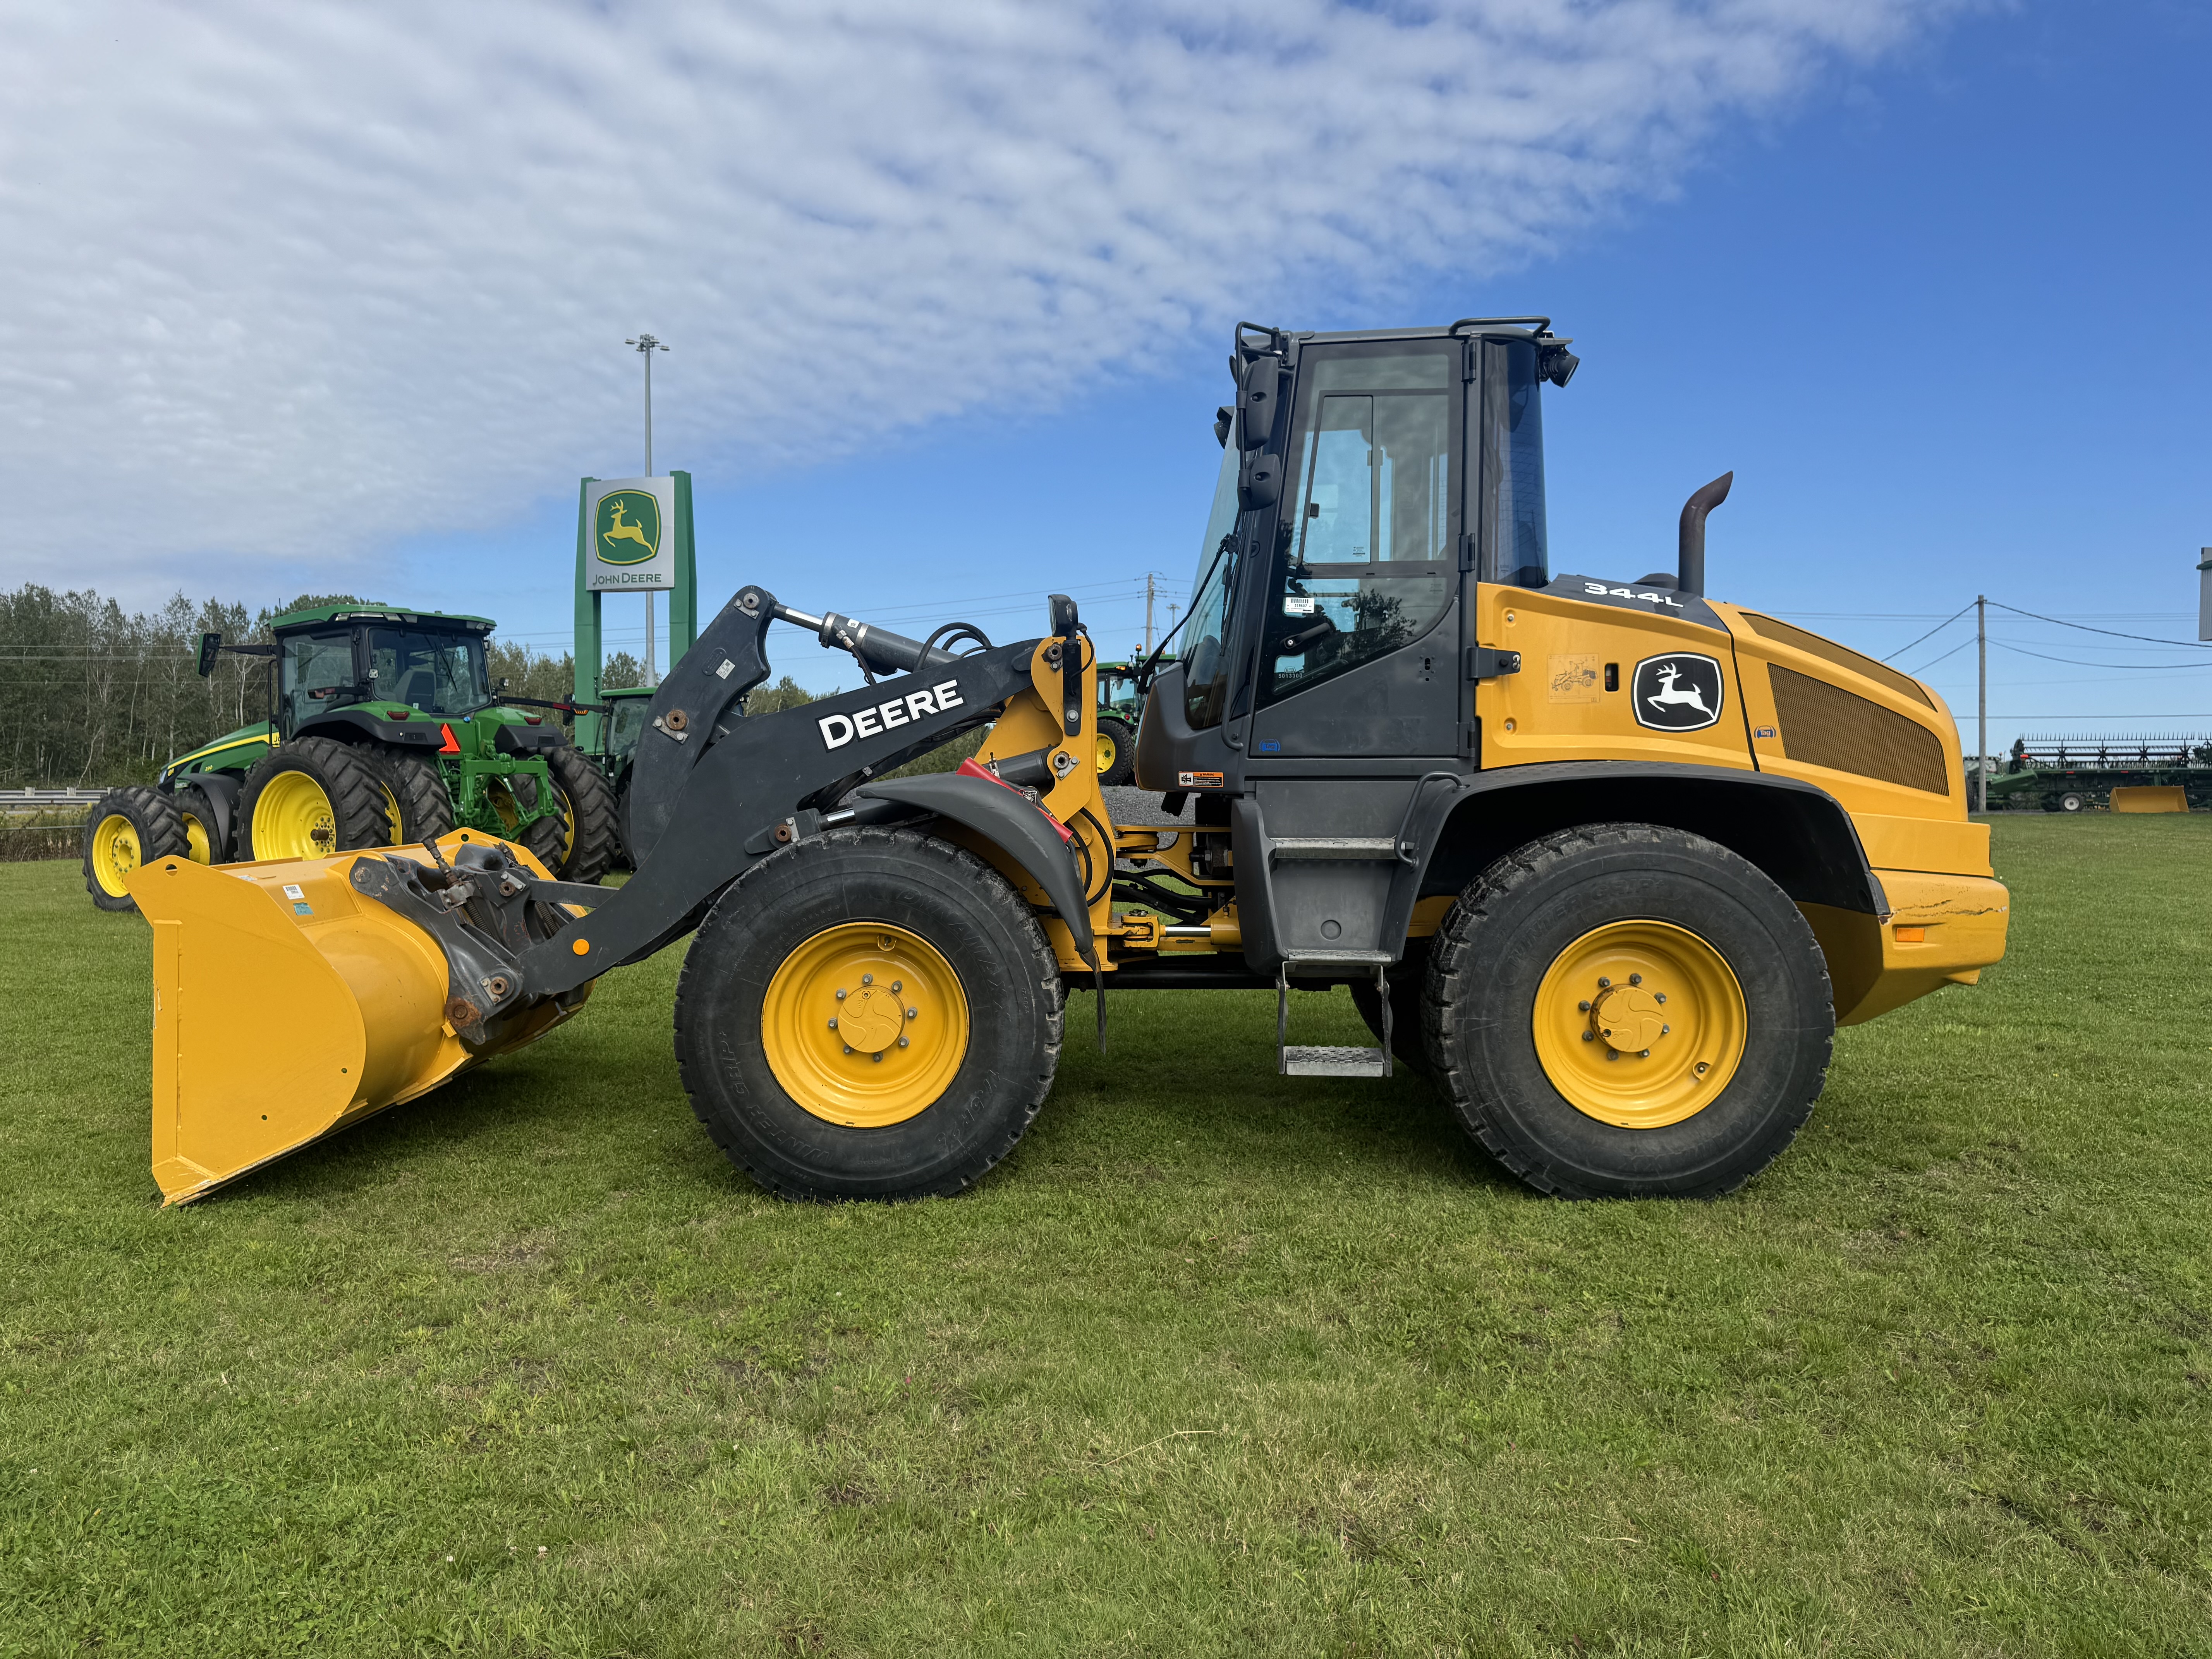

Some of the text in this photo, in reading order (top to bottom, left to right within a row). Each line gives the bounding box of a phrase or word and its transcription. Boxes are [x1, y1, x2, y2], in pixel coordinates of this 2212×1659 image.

[592, 573, 661, 586] JOHN DEERE
[1584, 582, 1684, 608] 344L
[818, 679, 964, 750] DEERE
[895, 884, 1010, 1021] DYNAMAXX
[1505, 890, 1586, 970] WINTER
[744, 1100, 831, 1167] WINTER
[932, 1069, 1003, 1150] 17.5R25
